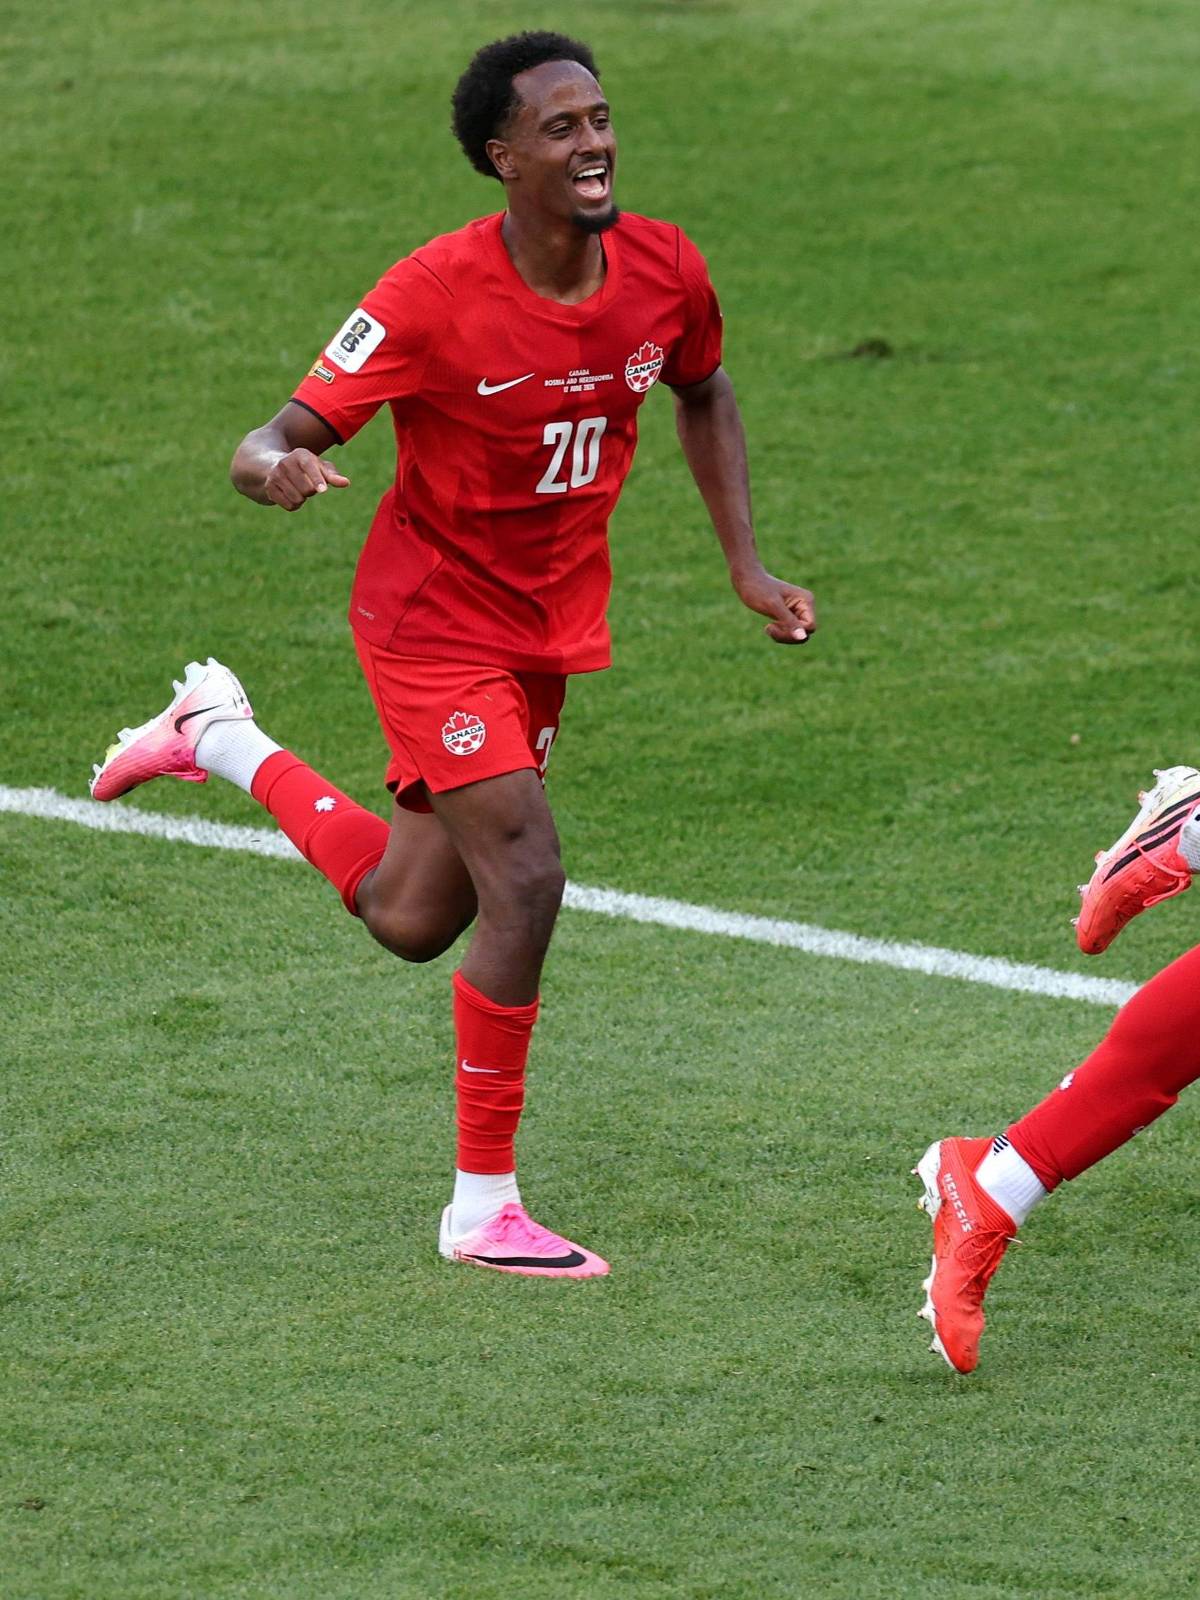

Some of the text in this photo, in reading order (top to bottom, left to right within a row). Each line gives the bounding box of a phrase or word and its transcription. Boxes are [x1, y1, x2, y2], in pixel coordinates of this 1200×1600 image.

[626, 360, 662, 376] CANADA
[535, 416, 608, 494] 20
[444, 725, 484, 743] CANADA
[943, 1172, 973, 1233] NEMESIS
